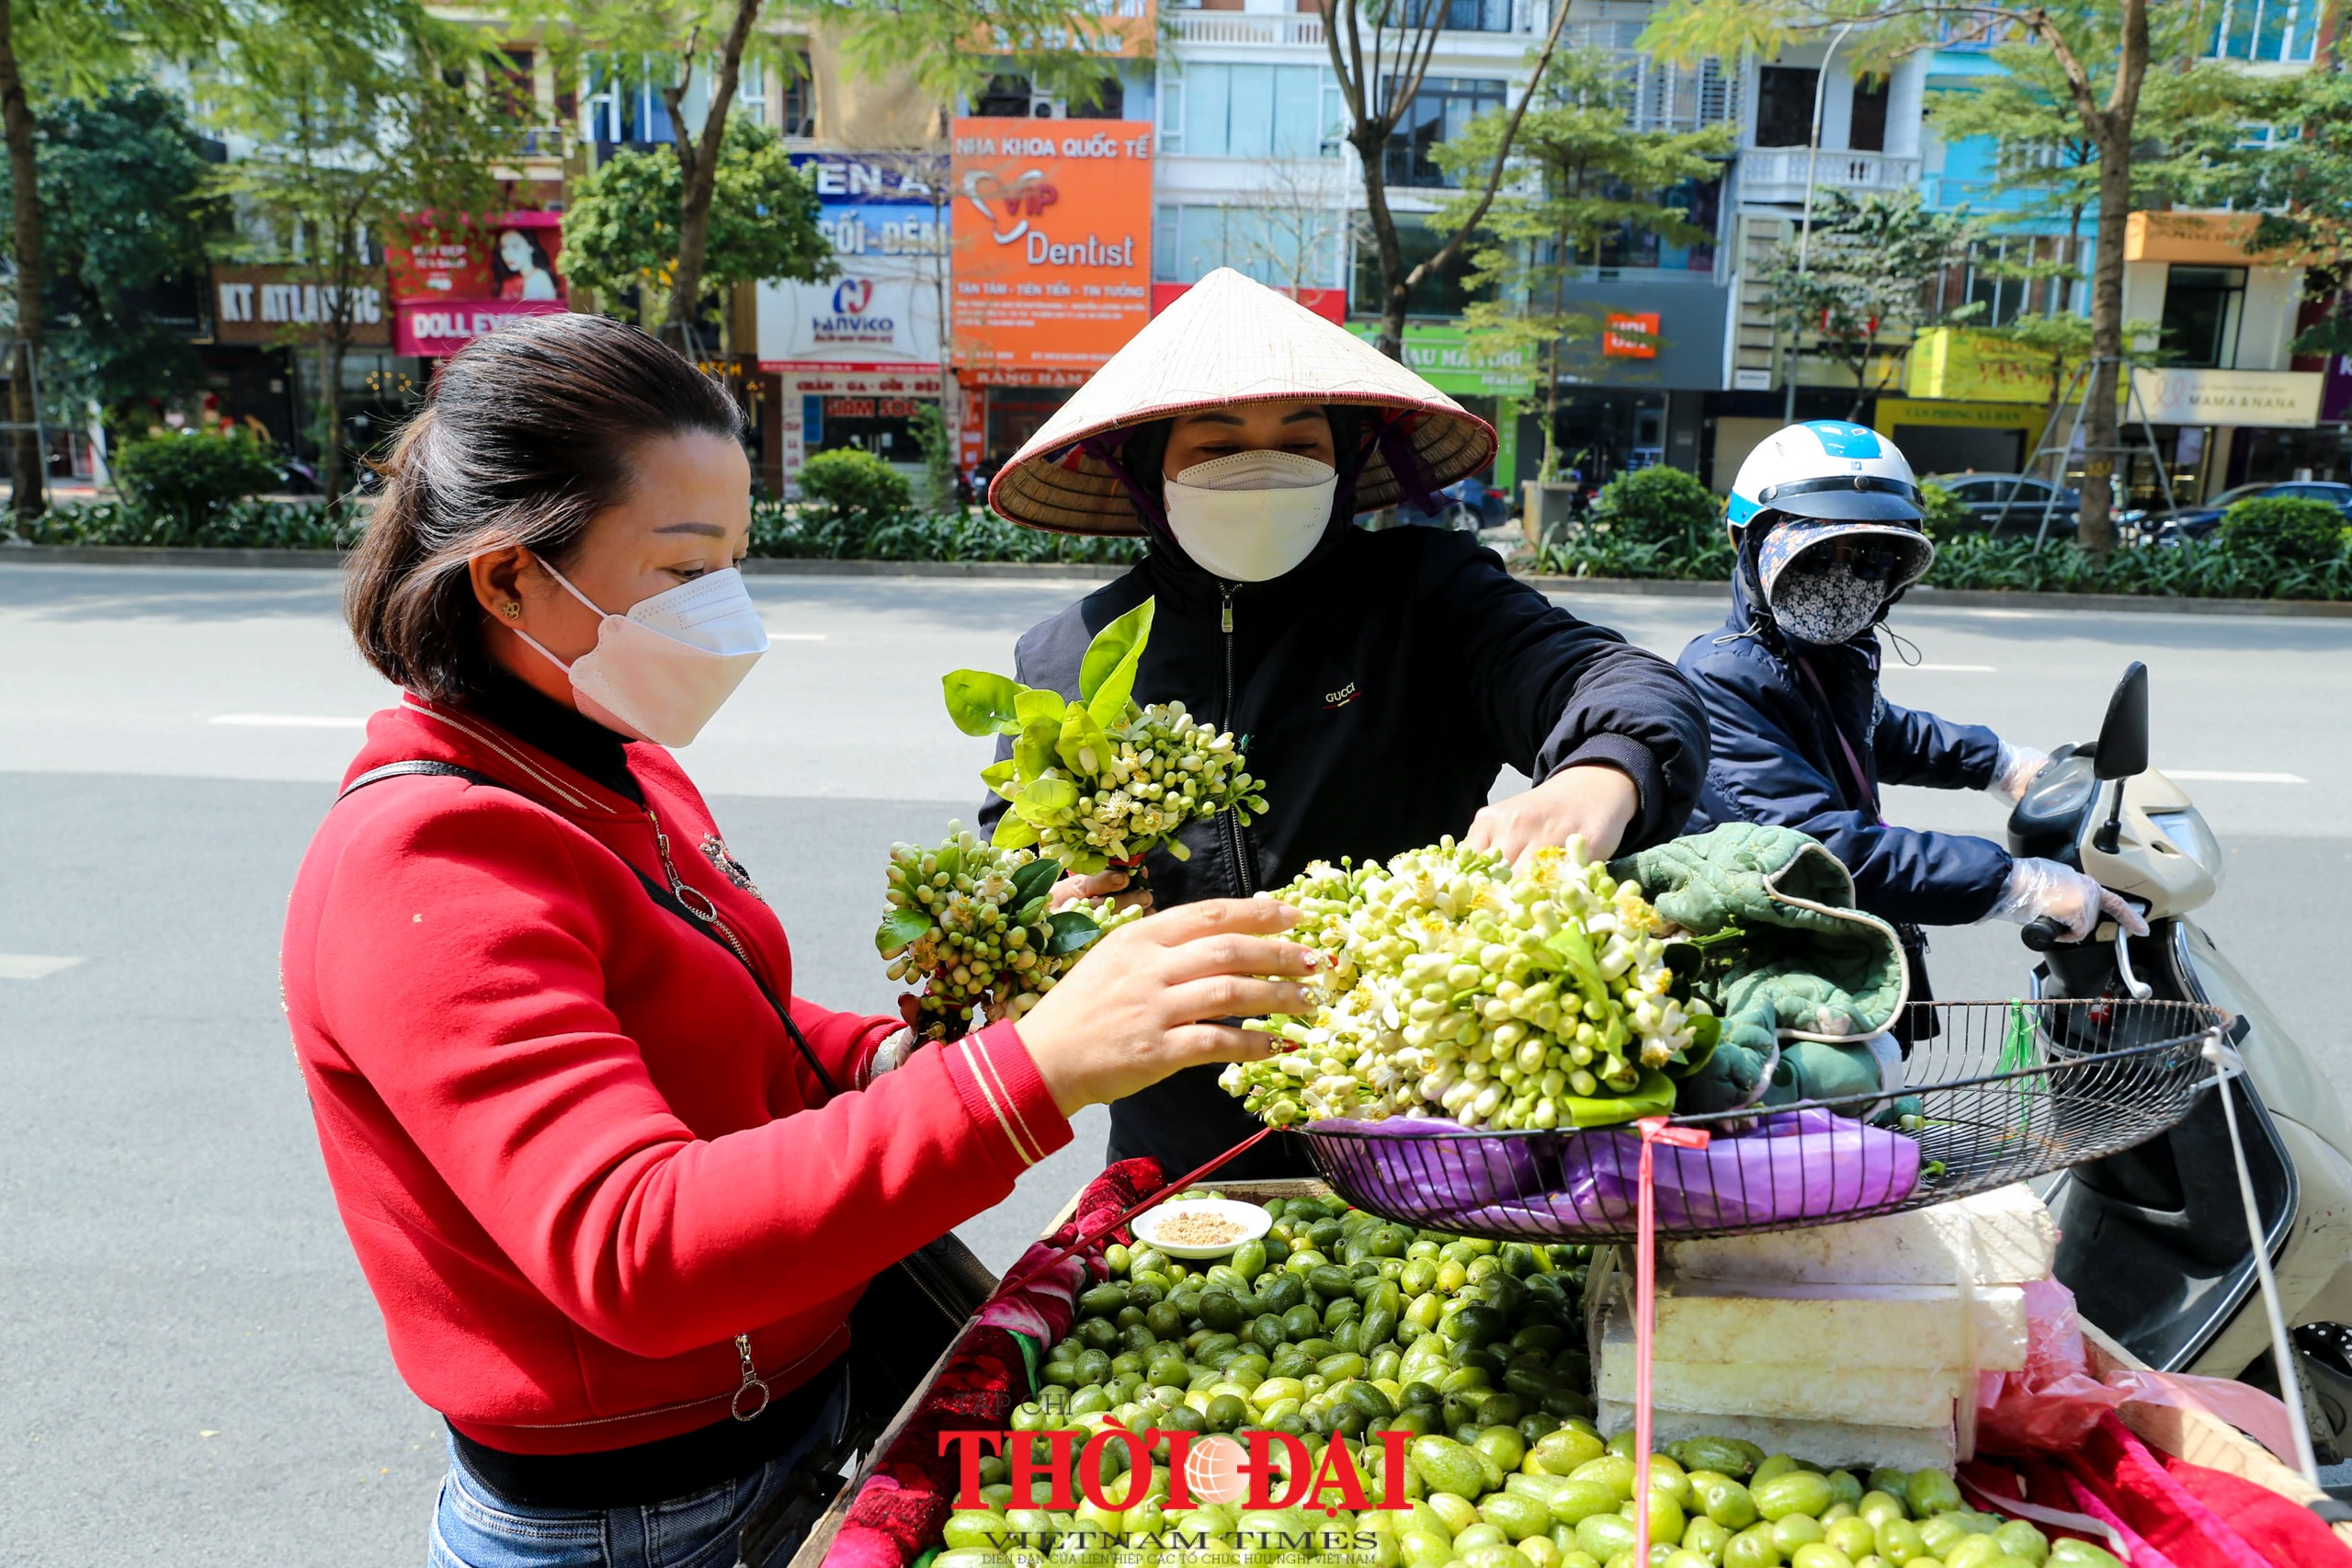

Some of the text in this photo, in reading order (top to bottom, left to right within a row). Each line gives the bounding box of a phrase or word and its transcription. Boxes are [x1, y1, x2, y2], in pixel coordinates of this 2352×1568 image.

[1002, 138, 1056, 157] KHOA
[1062, 131, 1118, 158] QUỐC
[1123, 132, 1150, 159] TẾ
[1005, 184, 1059, 216] VIP
[1027, 231, 1134, 267] Dentist
[219, 282, 254, 323] KT
[1325, 681, 1356, 703] GUCCI
